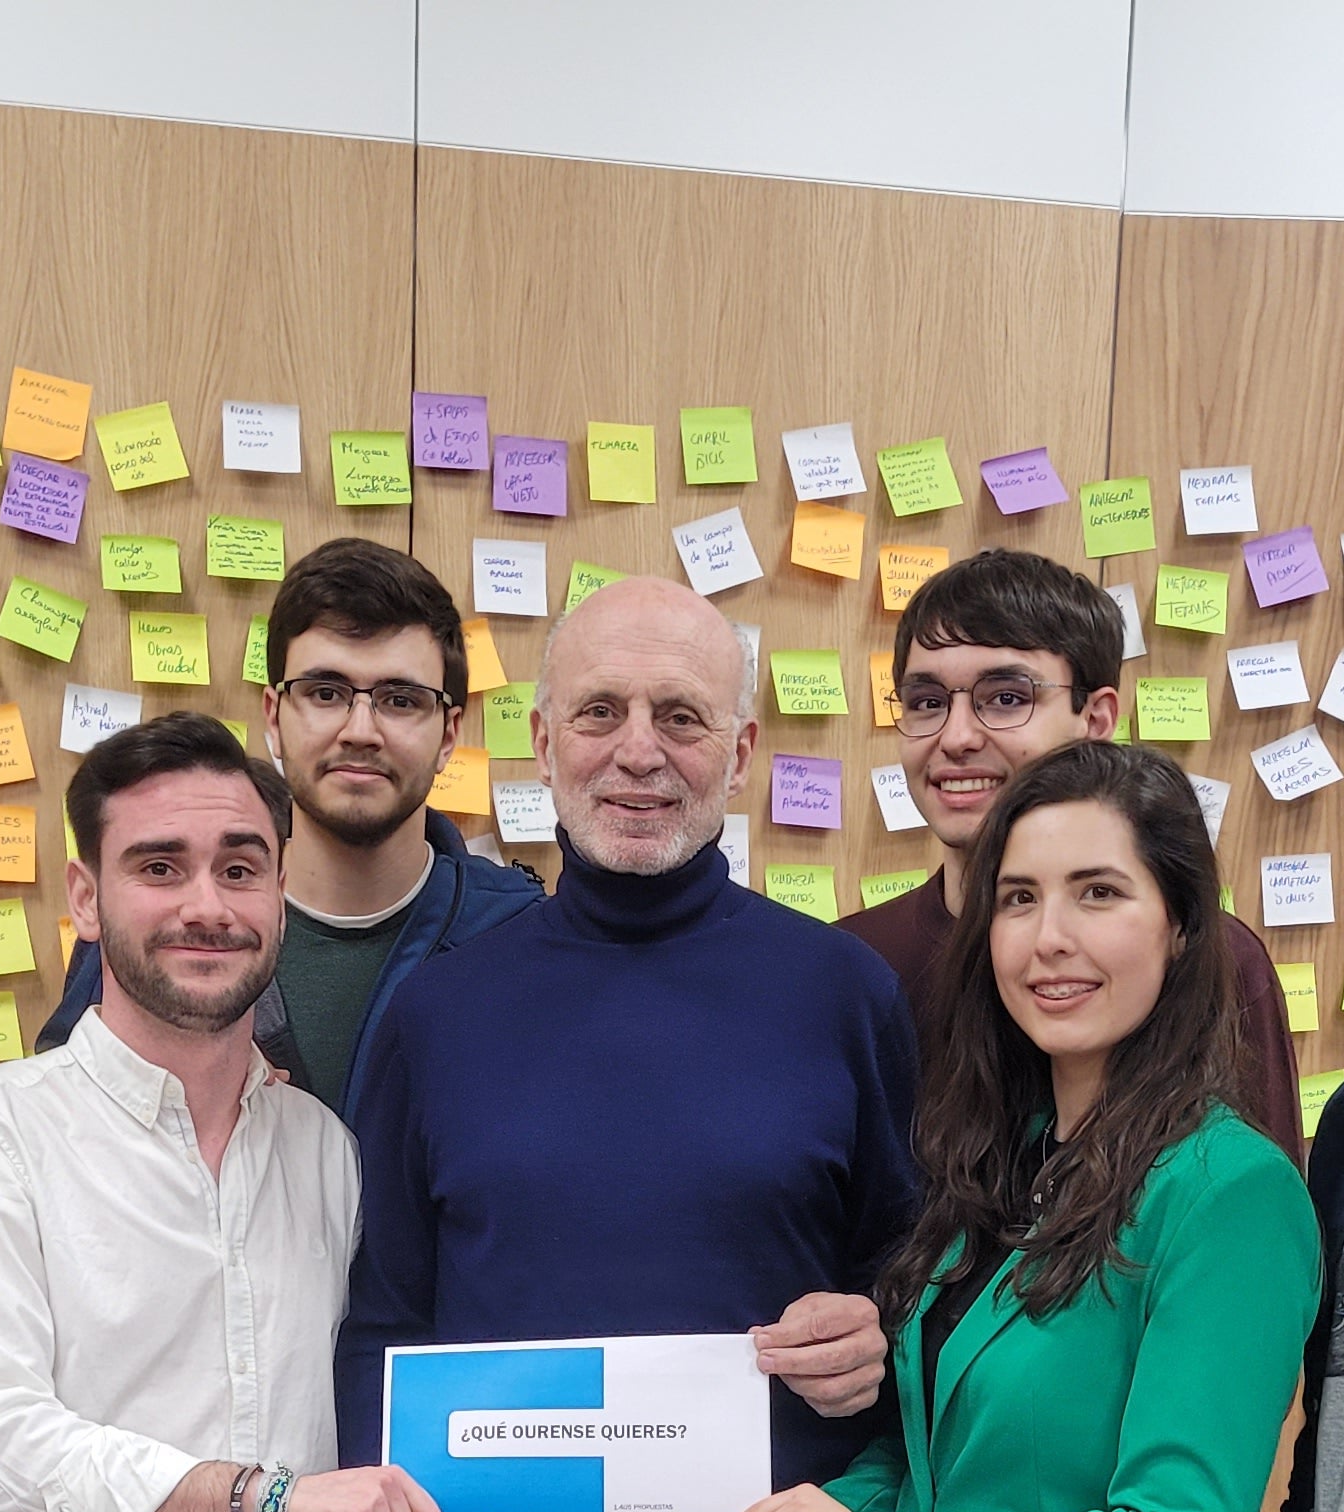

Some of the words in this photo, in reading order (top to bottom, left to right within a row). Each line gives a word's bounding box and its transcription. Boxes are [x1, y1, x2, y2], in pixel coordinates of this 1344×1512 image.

[461, 1421, 506, 1442] ¿QUÉ
[512, 1424, 596, 1439] OURENSE
[601, 1424, 687, 1440] QUIERES?
